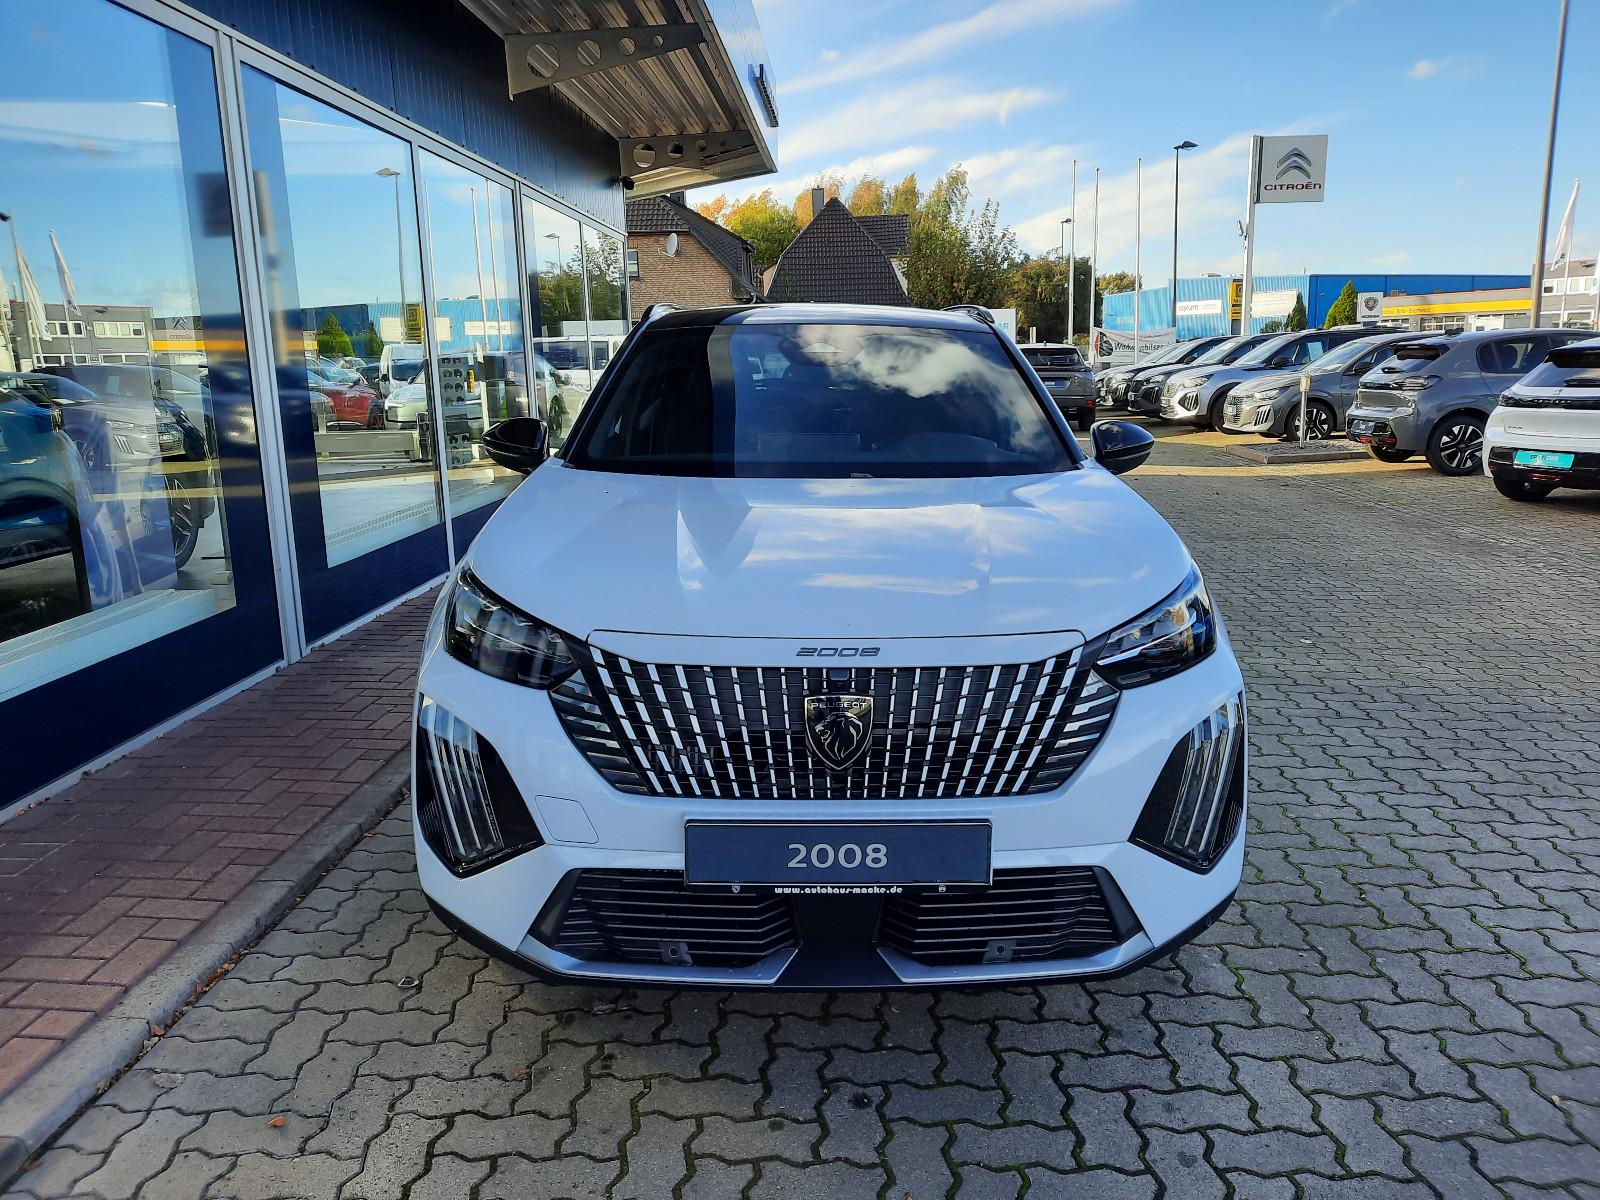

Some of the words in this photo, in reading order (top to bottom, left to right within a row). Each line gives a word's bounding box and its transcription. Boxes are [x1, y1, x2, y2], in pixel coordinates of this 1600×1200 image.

[796, 647, 881, 657] 2008
[810, 701, 868, 710] PEUGEOT
[786, 842, 888, 868] 2008
[774, 885, 903, 895] www.autohaus-macke.de
